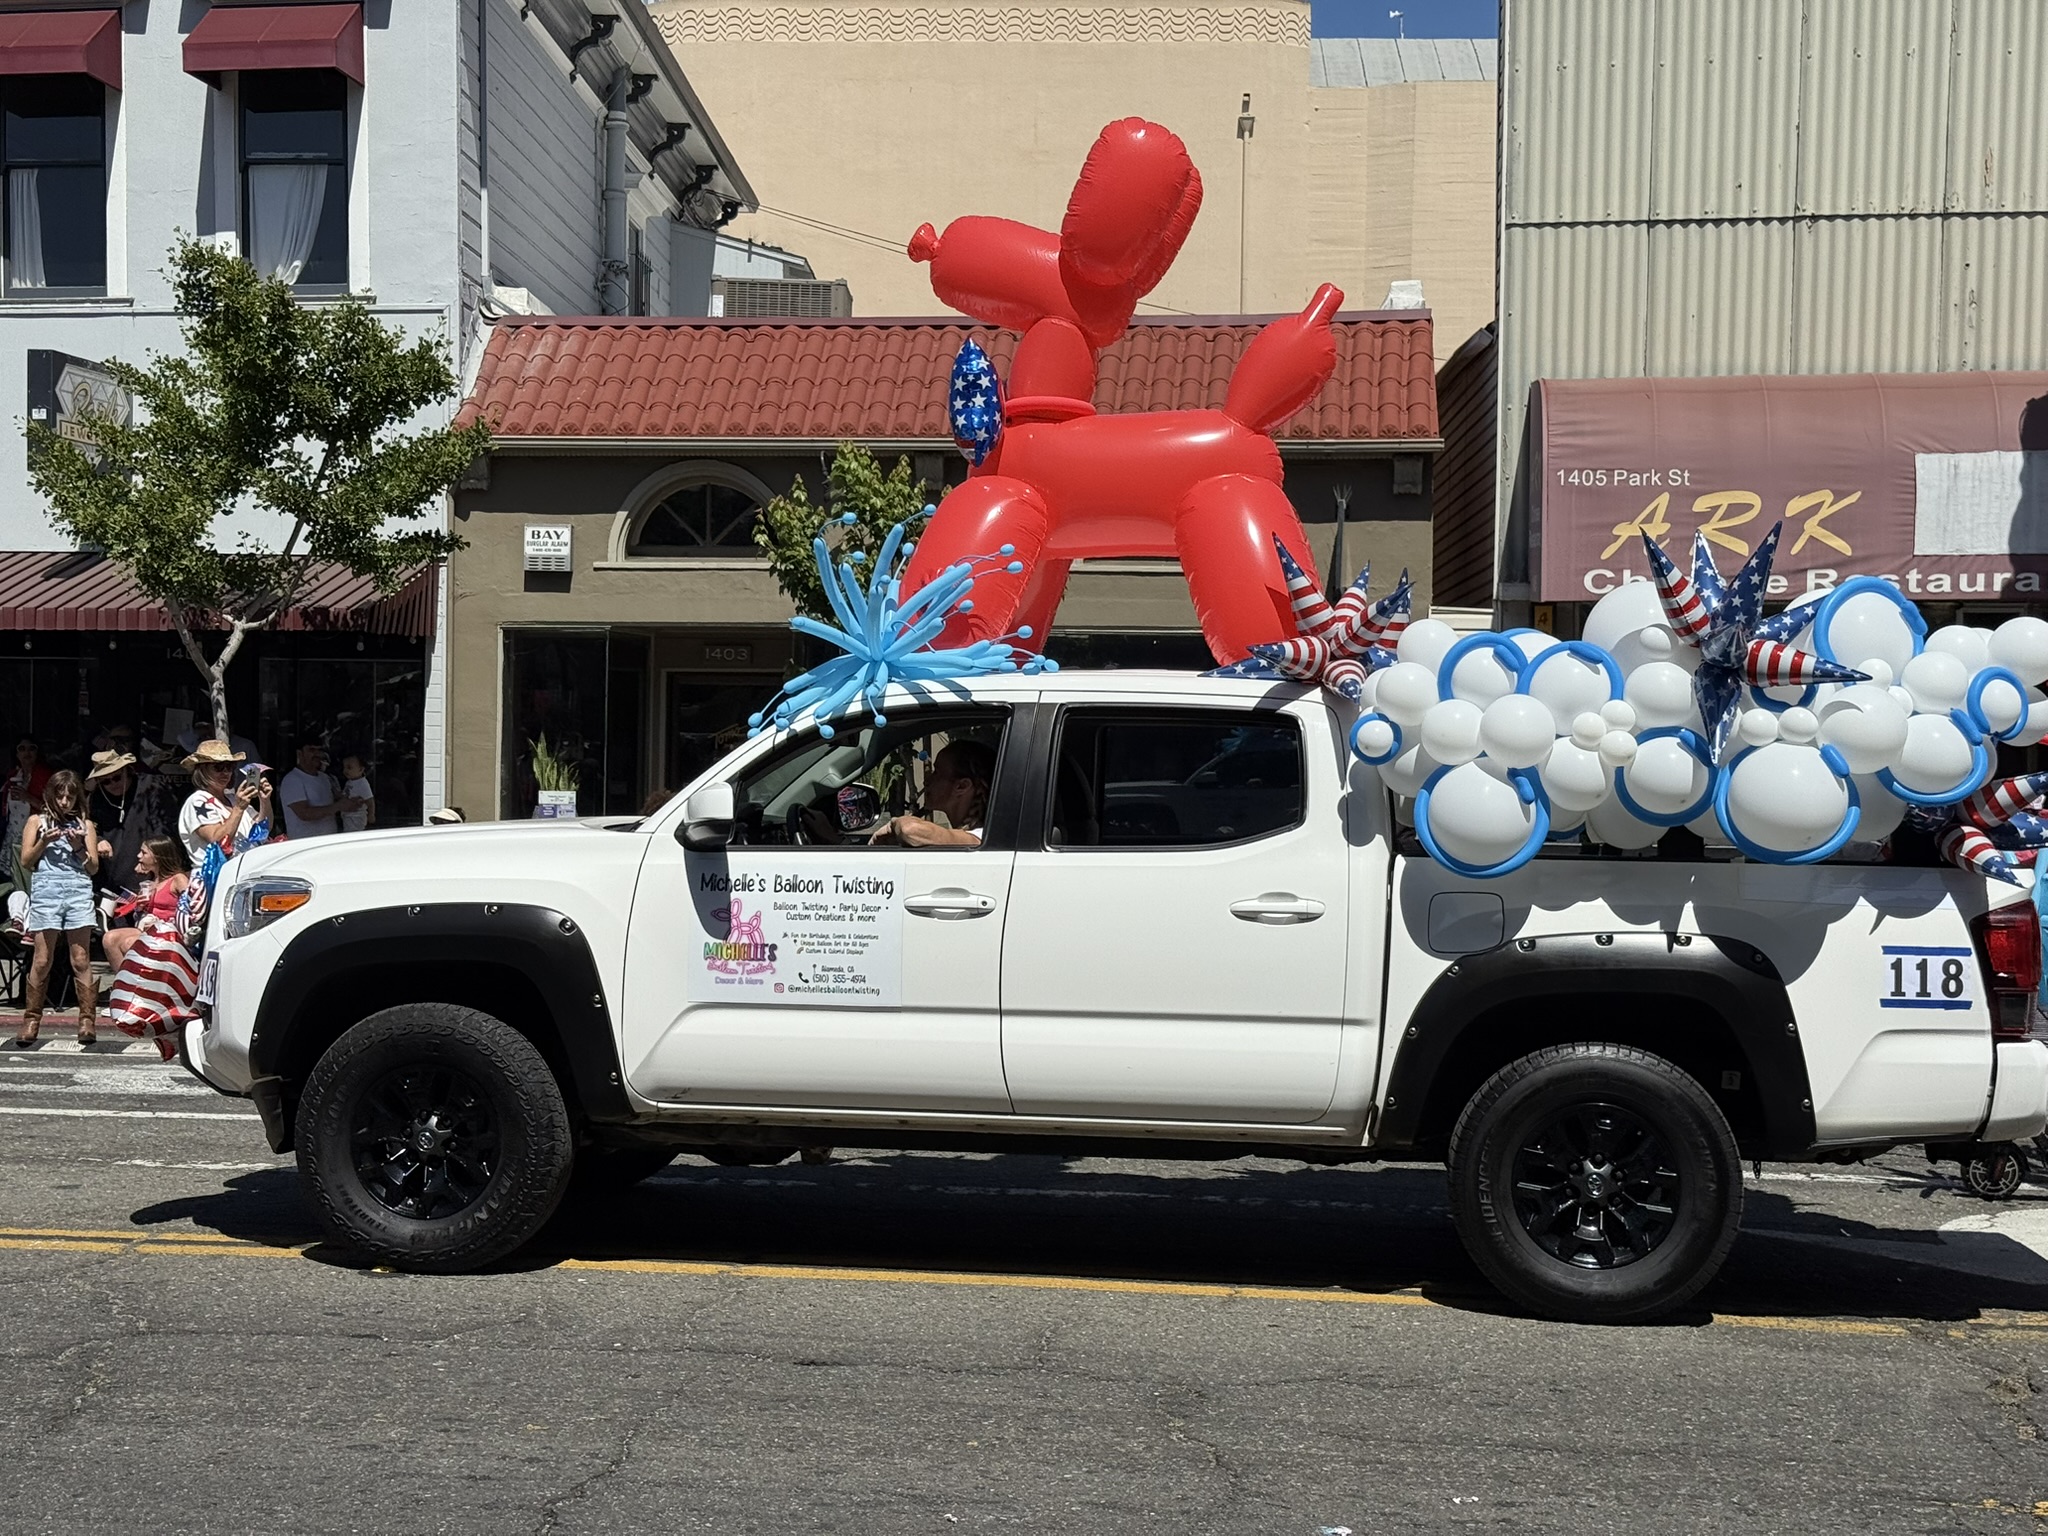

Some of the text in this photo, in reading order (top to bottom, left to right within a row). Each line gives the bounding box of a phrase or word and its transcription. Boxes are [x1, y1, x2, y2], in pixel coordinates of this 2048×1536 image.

[1556, 469, 1690, 486] 1405 Park St
[531, 530, 565, 540] BAY
[705, 648, 748, 660] 1403
[700, 872, 894, 900] Michelle's Balloon Twisting
[773, 902, 881, 914] Balloon Twisting Party Decor
[786, 911, 876, 922] Custom Creations & more
[821, 965, 845, 973] Alameda,
[812, 974, 866, 984] (510) 355-4974
[1890, 957, 1964, 999] 118
[788, 984, 880, 996] @michellesballoontwisting
